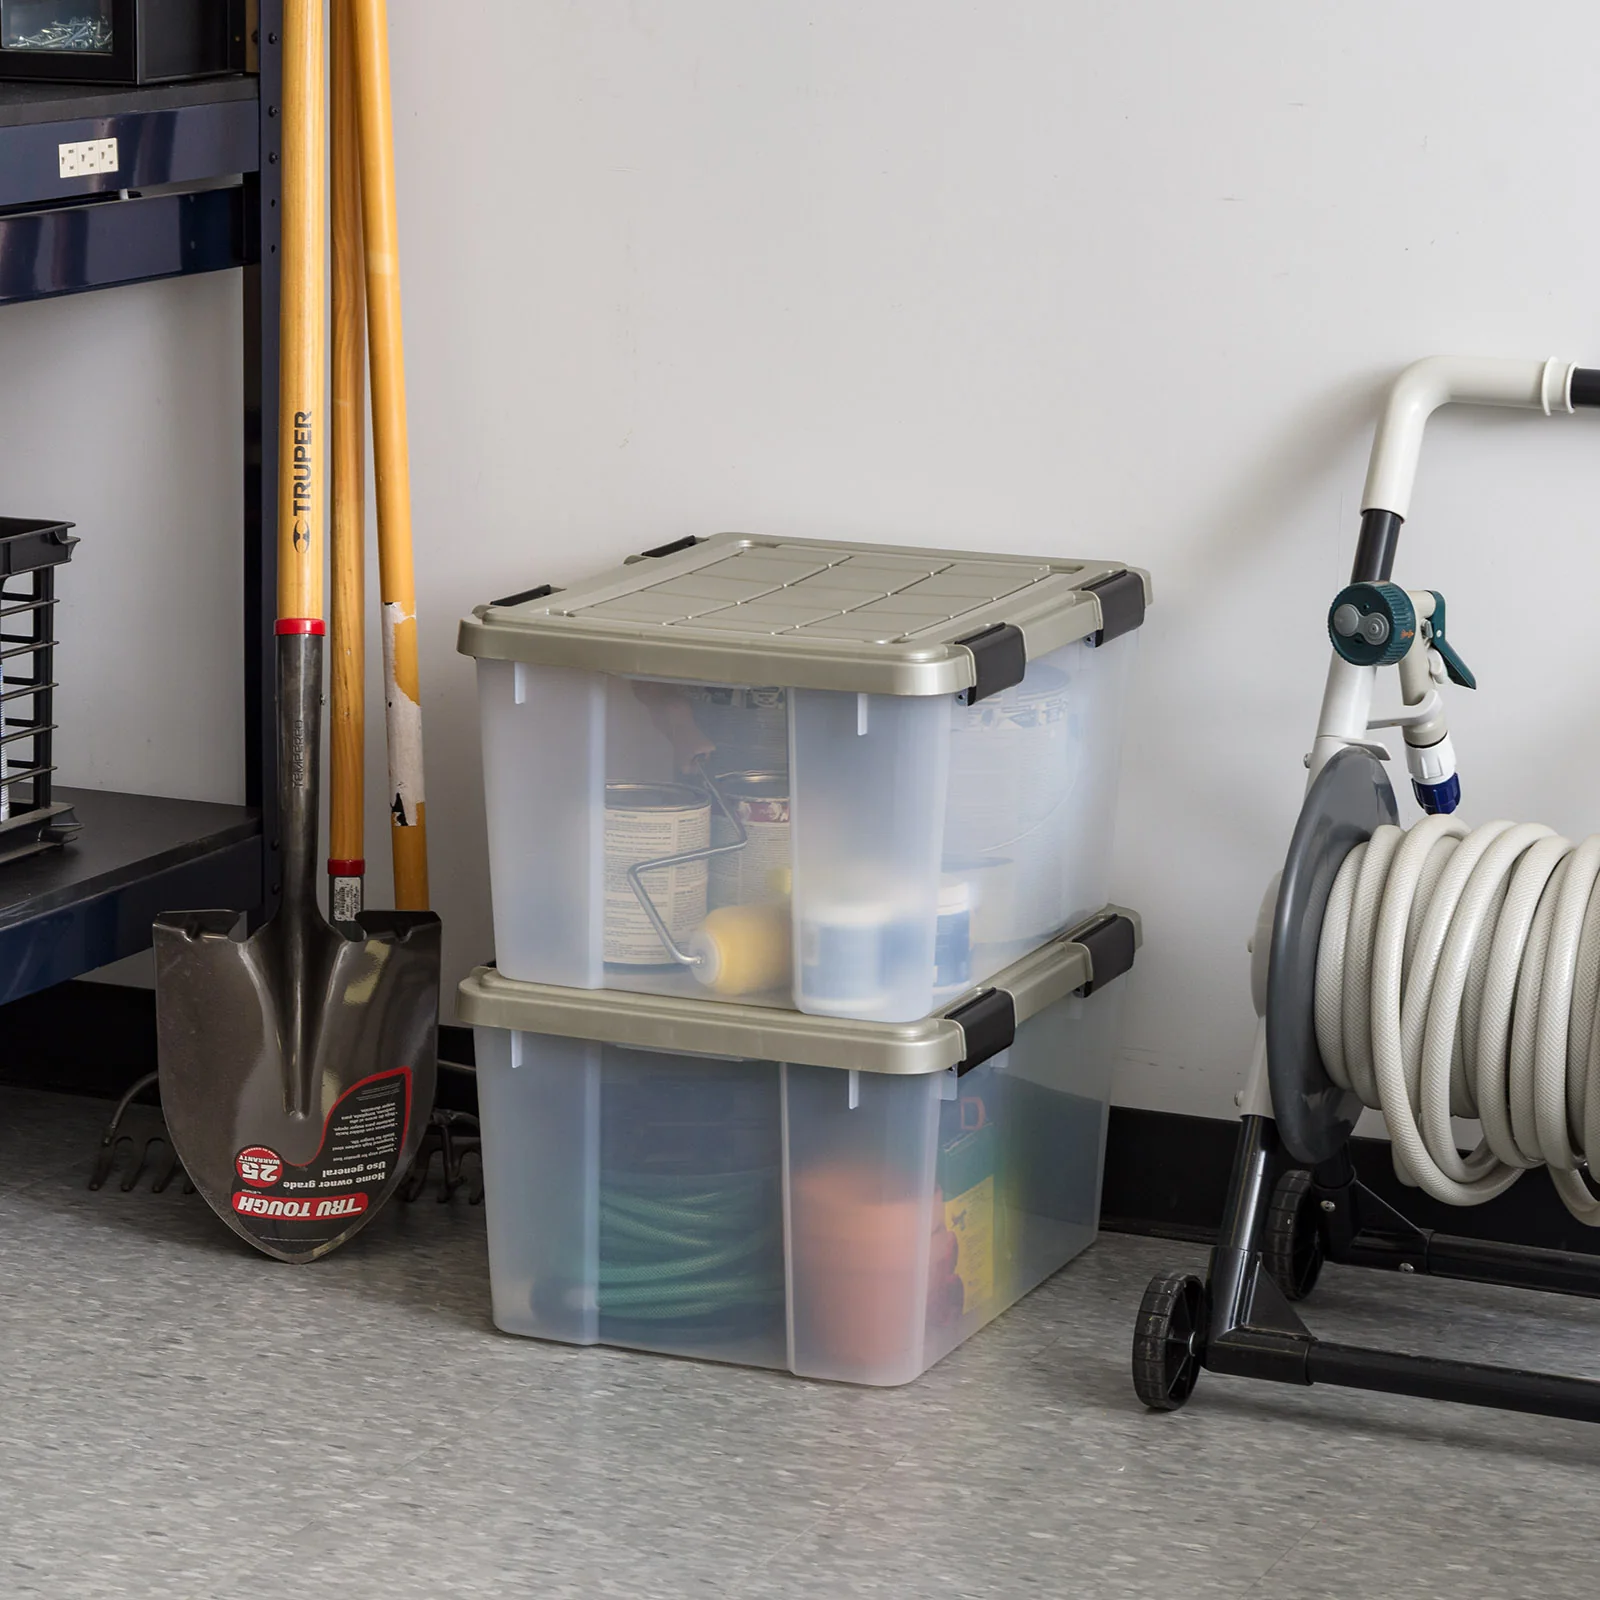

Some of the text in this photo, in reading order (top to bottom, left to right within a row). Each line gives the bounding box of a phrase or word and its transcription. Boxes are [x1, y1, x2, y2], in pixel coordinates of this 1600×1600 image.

[293, 411, 312, 516] TRUPER
[293, 720, 304, 788] TEMPERED
[238, 1155, 280, 1164] WARRANTY
[322, 1161, 386, 1178] Uso general
[242, 1162, 278, 1182] 25
[283, 1172, 385, 1190] Home owner grade
[238, 1196, 362, 1217] TRU TOUGH
